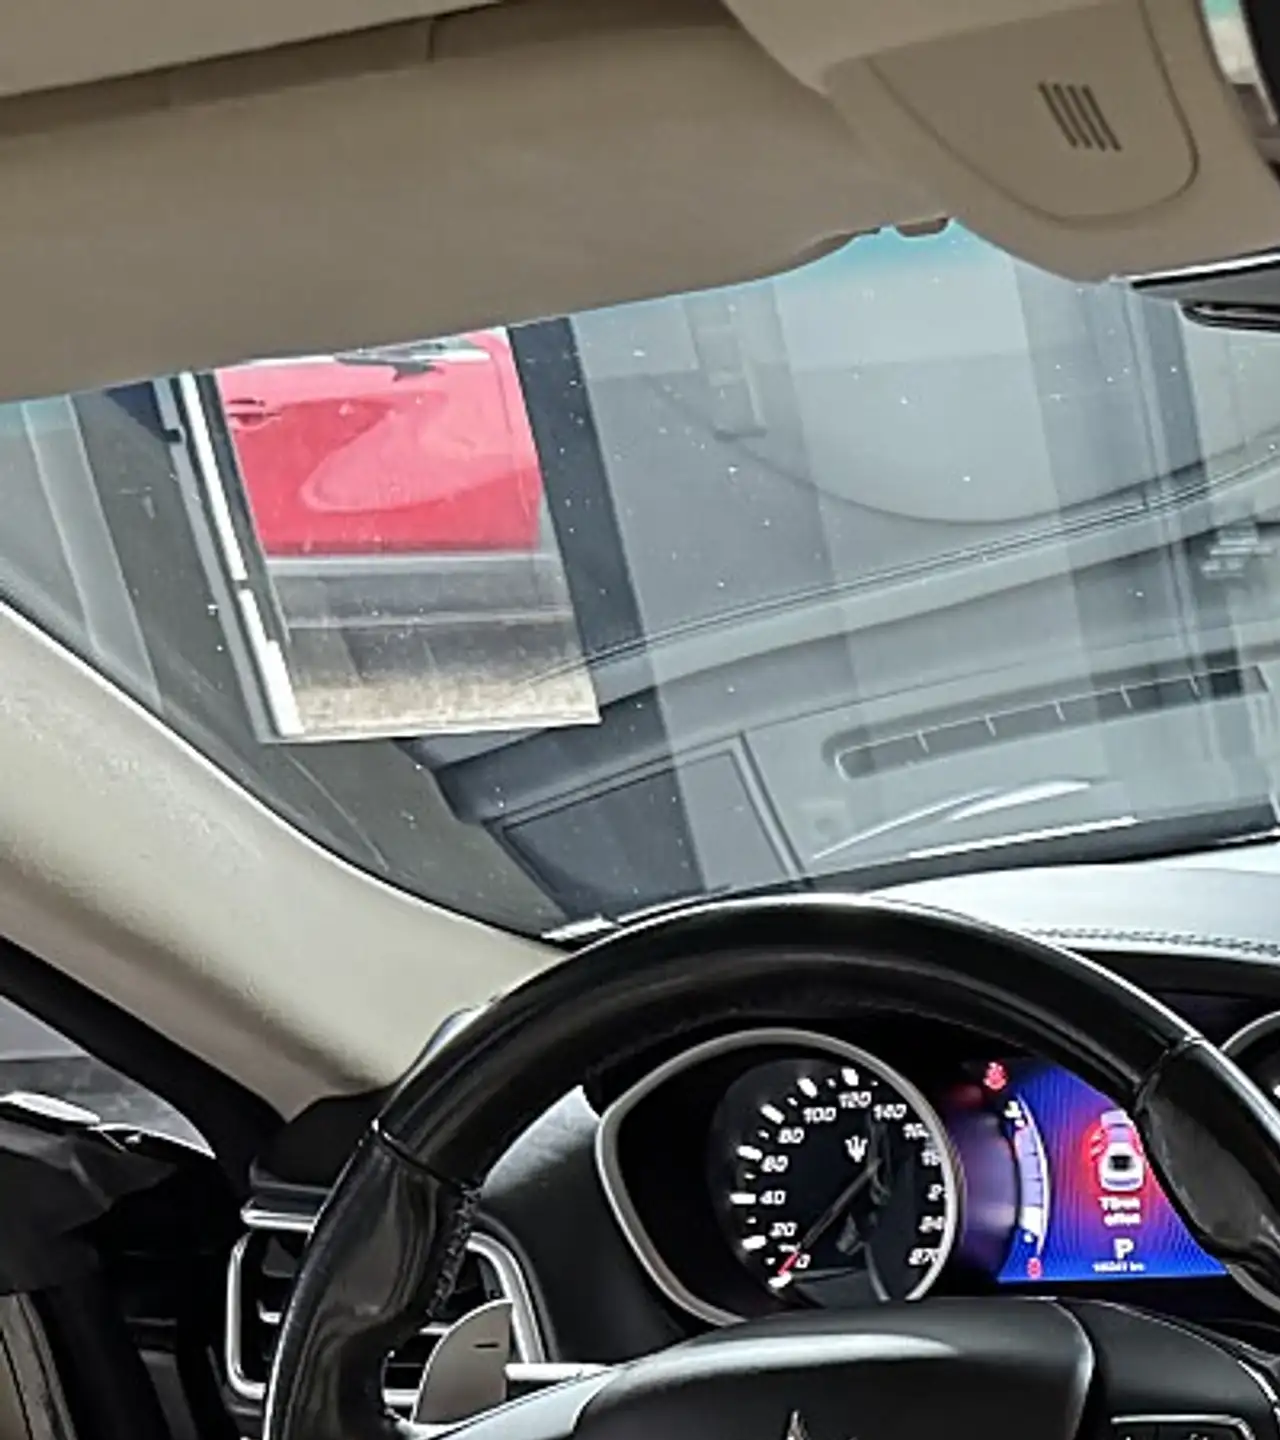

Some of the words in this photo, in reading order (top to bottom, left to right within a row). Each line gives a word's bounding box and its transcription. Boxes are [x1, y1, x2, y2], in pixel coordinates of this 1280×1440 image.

[839, 1091, 872, 1108] 120
[803, 1106, 837, 1124] 100
[873, 1104, 907, 1120] 140
[777, 1127, 805, 1144] 80
[761, 1155, 789, 1173] 60
[760, 1190, 787, 1205] 40
[769, 1221, 798, 1237] 20
[1113, 1238, 1134, 1260] P
